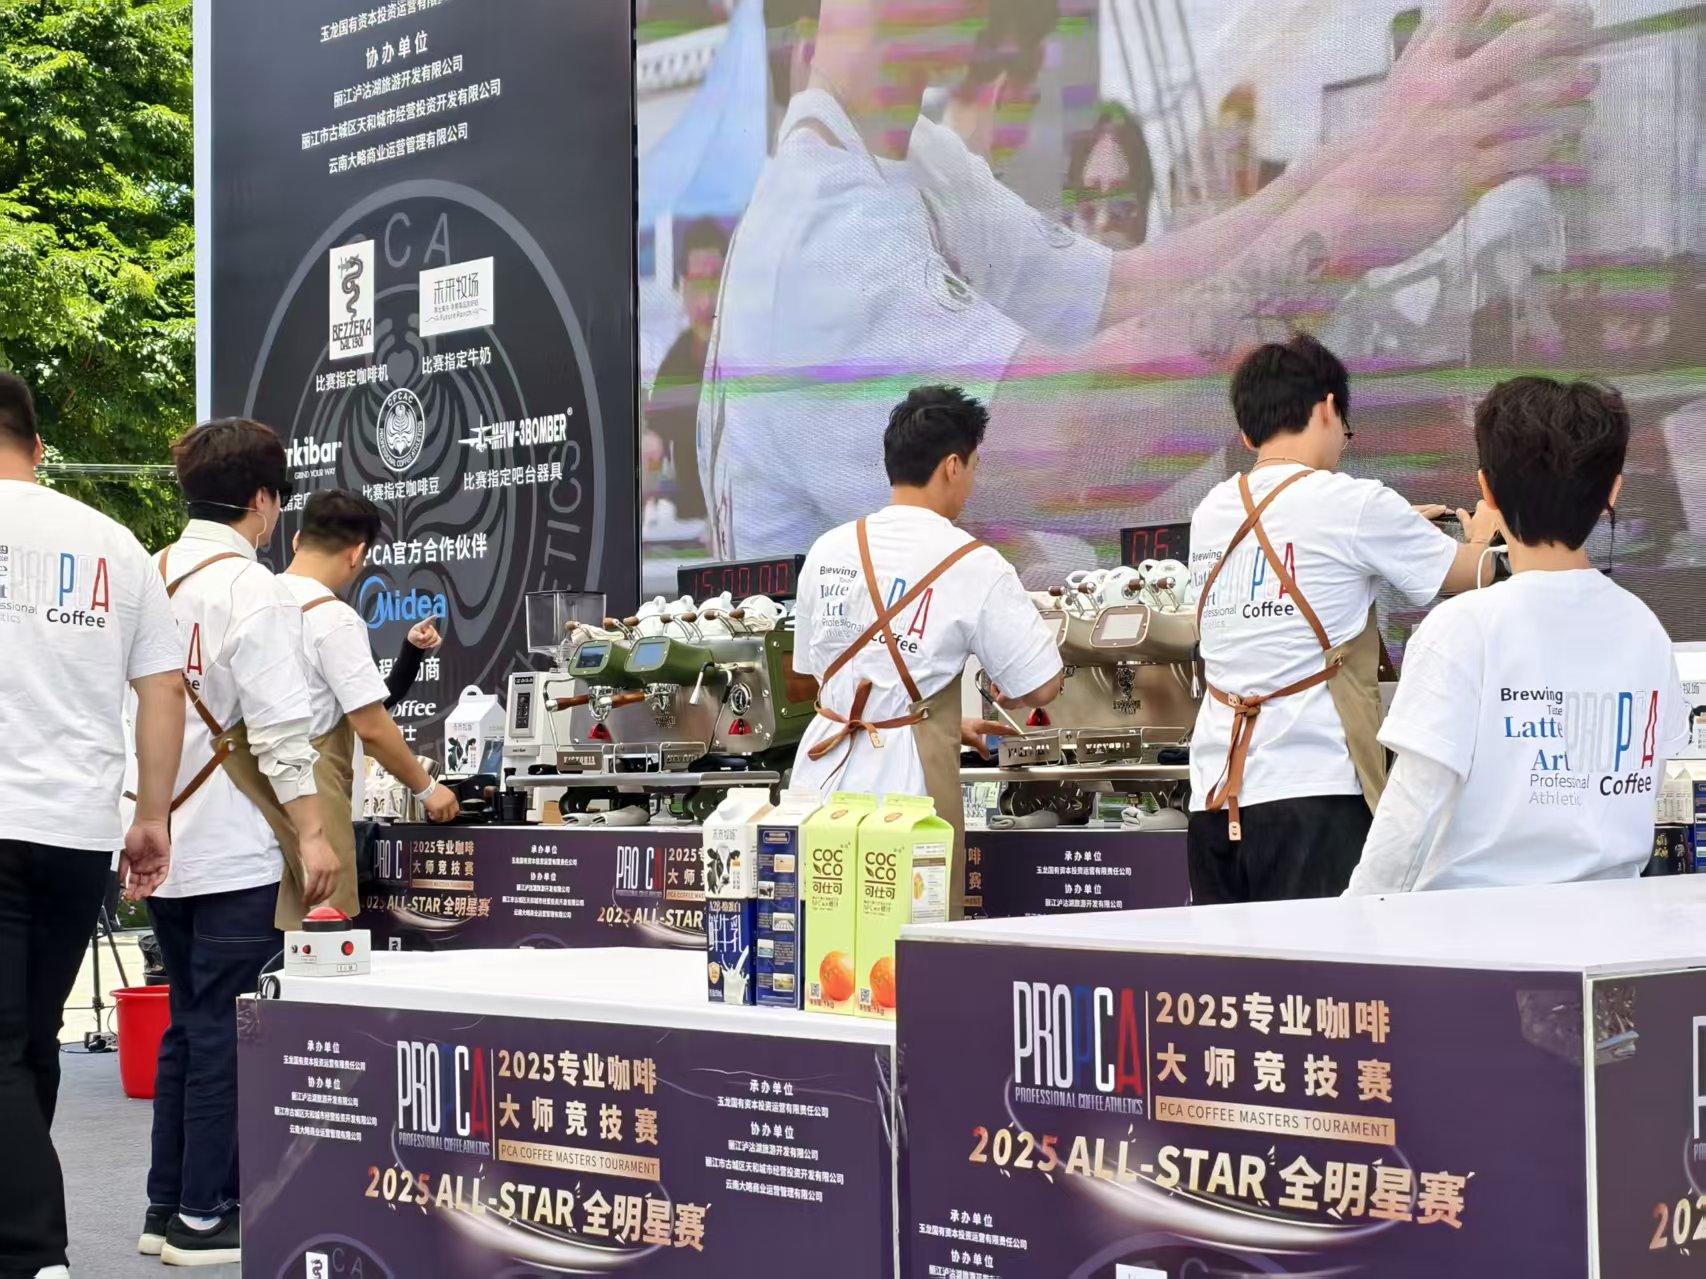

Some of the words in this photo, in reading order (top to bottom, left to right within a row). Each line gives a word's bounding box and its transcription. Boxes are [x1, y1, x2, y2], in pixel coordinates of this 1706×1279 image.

[366, 30, 428, 69] 协办单位
[333, 55, 462, 108] 丽江泸沽湖旅游开发有限公司
[302, 78, 500, 150] 丽江市古城区天和城市经营投资开发有限公司
[328, 122, 468, 174] 云南大略商业运营管理有限公司
[332, 318, 372, 341] BEZZERA
[422, 347, 491, 375] 比赛指定牛奶
[316, 364, 388, 392] 比赛指定咖啡机
[463, 462, 562, 491] 比赛指定吧台器具
[363, 476, 440, 501] 比赛指定咖啡豆
[1192, 549, 1222, 561] Brewing
[360, 576, 446, 629] Midea
[1242, 601, 1294, 619] Coffee
[47, 608, 105, 628] Coffee
[1500, 686, 1563, 705] Brewing
[1504, 717, 1563, 738] Latte
[1531, 749, 1570, 771] Art
[1600, 773, 1652, 796] Coffee
[813, 848, 843, 862] COC
[865, 852, 896, 867] COC
[412, 860, 474, 876] 大师竞技赛
[822, 863, 843, 876] CO
[875, 867, 896, 881] CO
[813, 881, 842, 895] 可仕可
[865, 885, 896, 899] 可仕可
[387, 896, 440, 913] ALL-STAR
[443, 896, 490, 917] 全明星赛
[597, 907, 631, 924] 2025
[633, 907, 703, 928] ALL-STAR
[1156, 991, 1390, 1043] 2025专业咖啡
[498, 1050, 657, 1095] 2025专业咖啡
[1156, 1043, 1392, 1103] 大师竞技赛
[750, 1079, 794, 1096] 承办单位
[1015, 1087, 1076, 1108] PROFESSIONAL
[499, 1093, 658, 1145] 大师竞技赛
[1160, 1102, 1183, 1117] PCA
[1188, 1104, 1235, 1122] COFFEE
[1239, 1109, 1299, 1129] MASTERS
[1304, 1116, 1389, 1138] TOURAMENT
[751, 1121, 794, 1139] 协办单位
[398, 1132, 442, 1150] PROFESSIONAL
[501, 1144, 518, 1157] PCA
[520, 1147, 553, 1162] COFFEE
[556, 1152, 597, 1168] MASTERS
[600, 1156, 657, 1175] TOURAMENT
[969, 1125, 1059, 1173] 2025
[1065, 1136, 1266, 1200] ALL-STAR
[1279, 1155, 1466, 1229] 全明星赛
[365, 1166, 430, 1205] 2025
[436, 1174, 574, 1228] ALL-STAR
[583, 1190, 706, 1251] 全明星赛
[950, 1208, 993, 1228] 承办单位
[951, 1249, 994, 1268] 协办单位
